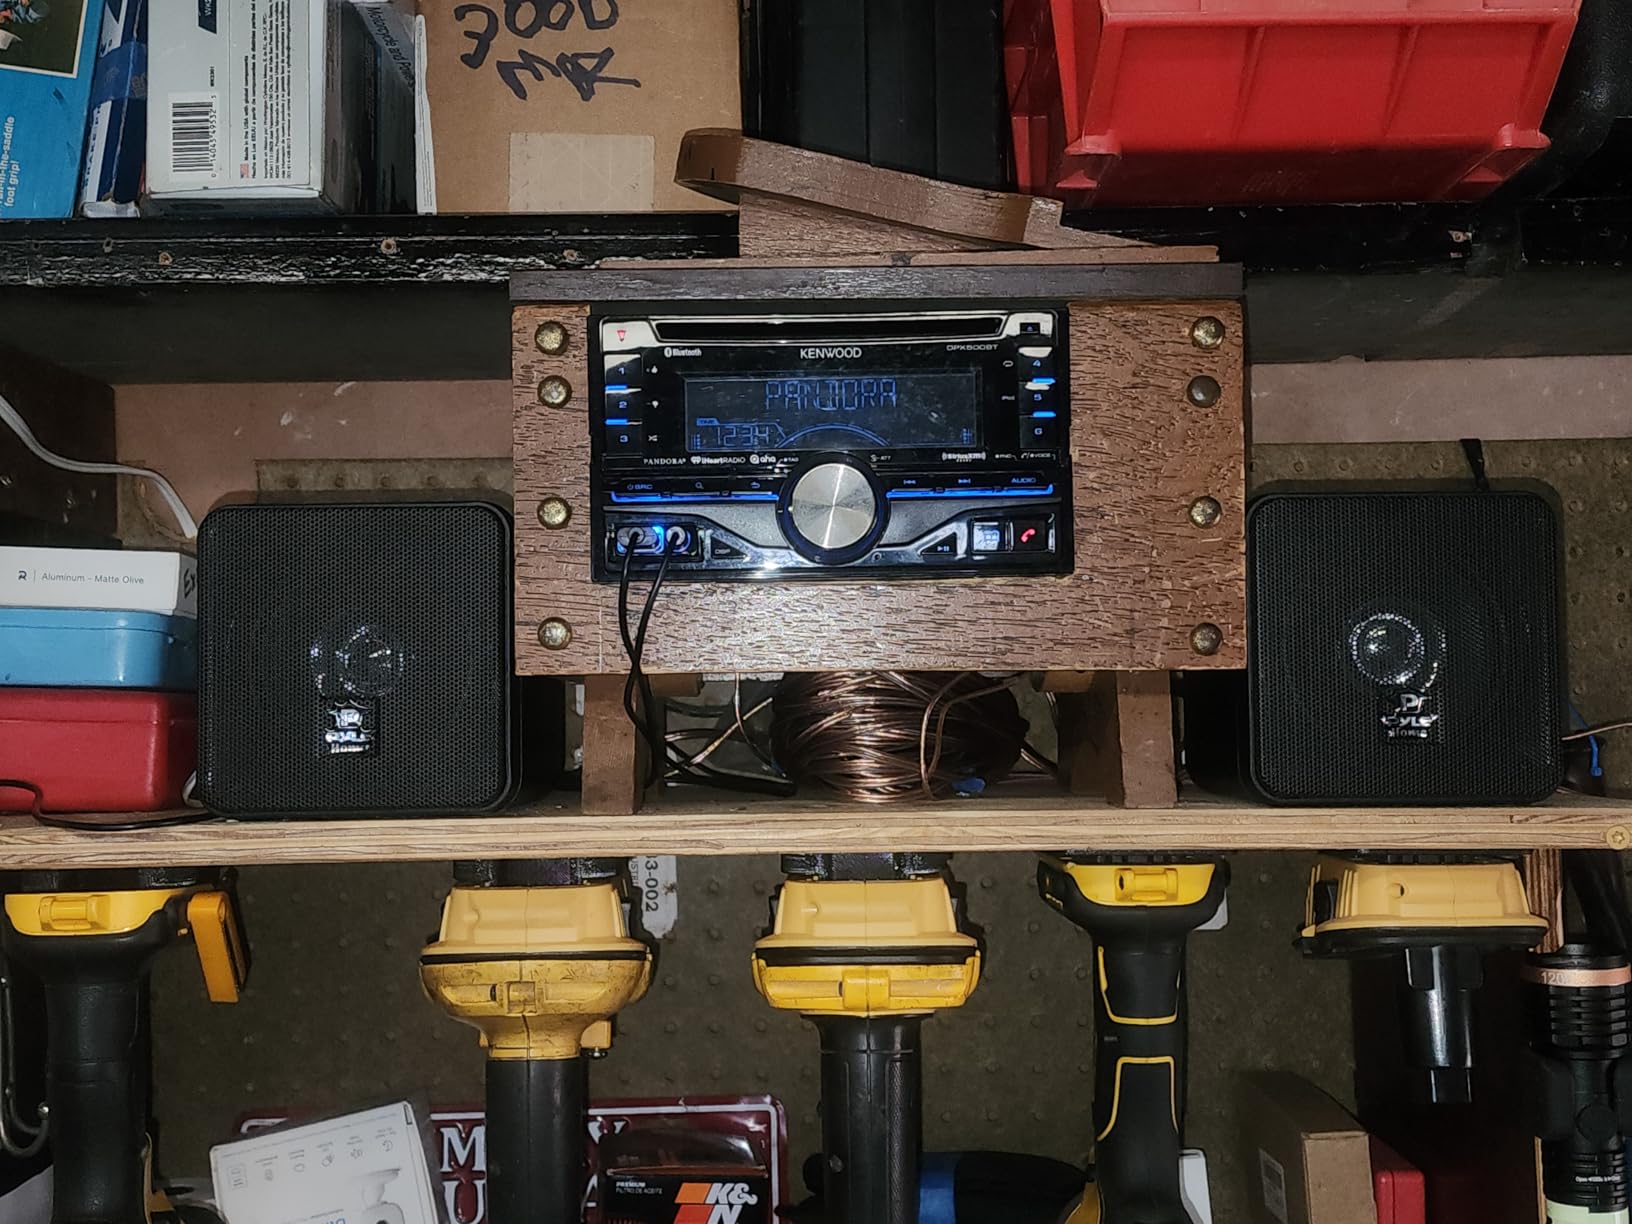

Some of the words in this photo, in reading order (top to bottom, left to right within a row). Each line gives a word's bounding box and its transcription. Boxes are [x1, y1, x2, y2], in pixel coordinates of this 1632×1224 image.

[672, 348, 702, 357] Bluetooth
[800, 348, 862, 359] KENWOOD
[766, 379, 896, 410] PANDORA
[41, 572, 85, 582] Aluminum
[94, 575, 119, 584] Matte
[122, 576, 144, 585] Olive
